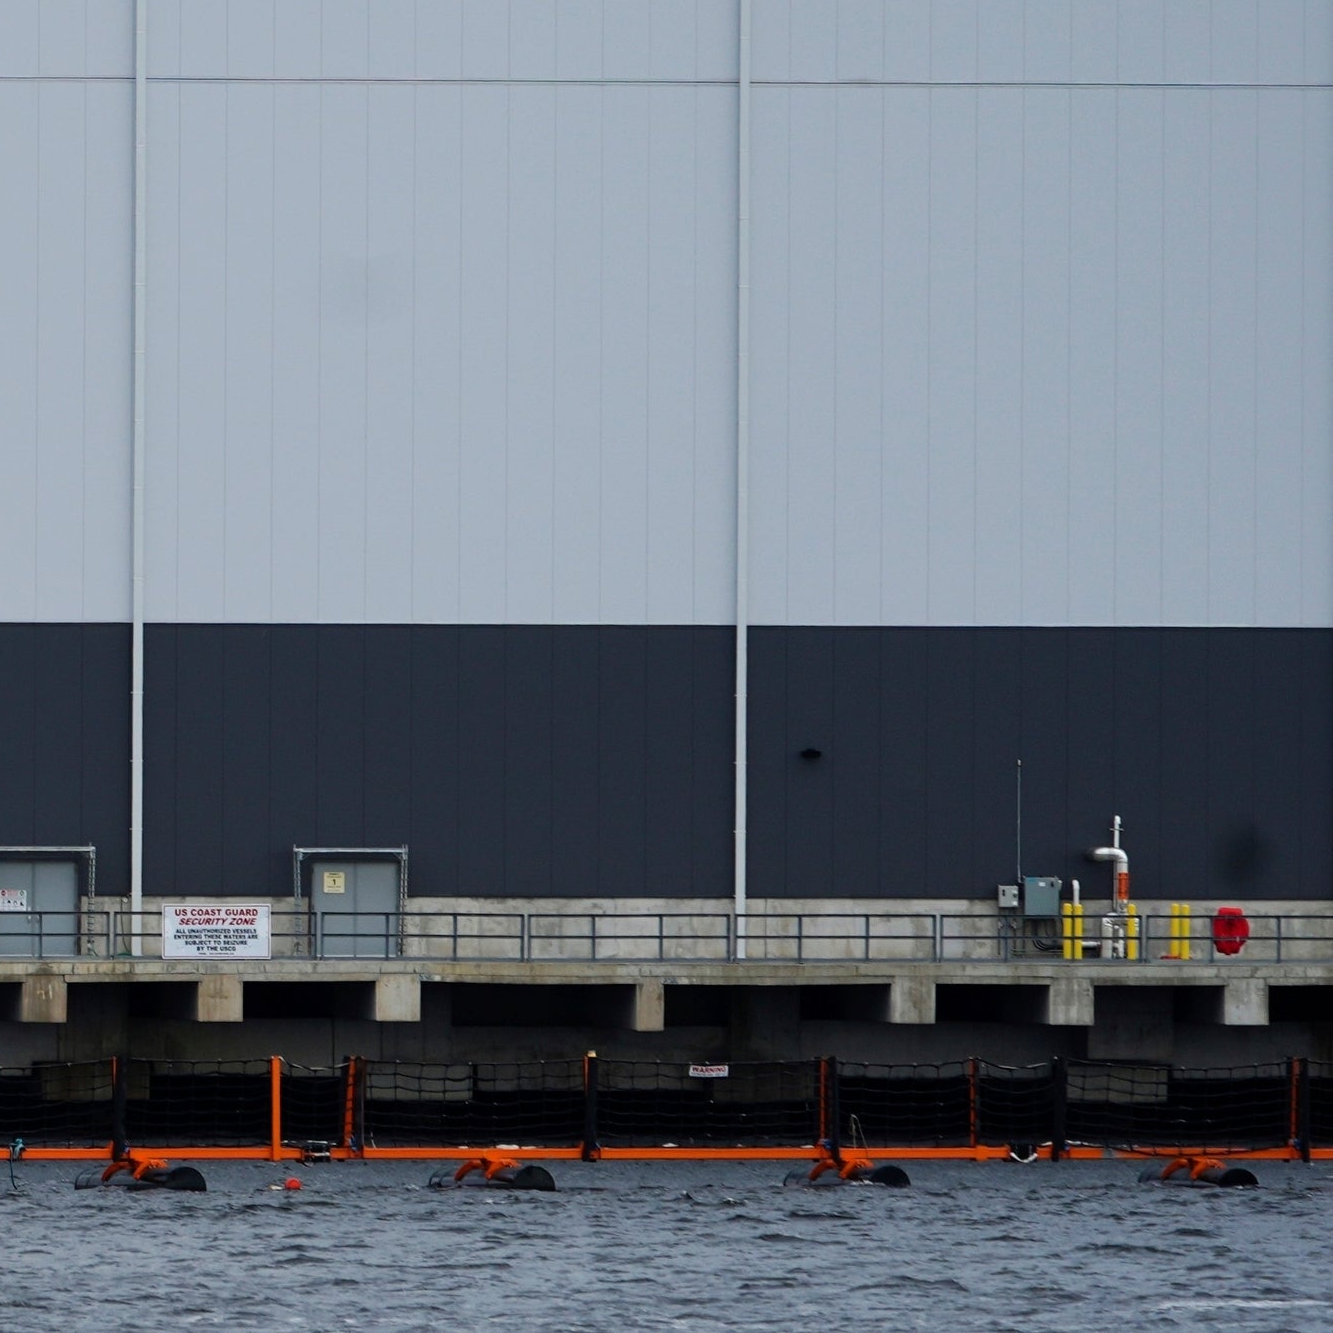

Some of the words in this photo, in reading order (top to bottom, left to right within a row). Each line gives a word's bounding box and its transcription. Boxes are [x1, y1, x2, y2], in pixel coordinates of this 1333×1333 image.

[174, 908, 188, 917] US
[190, 908, 222, 917] COAST
[225, 908, 259, 917] GUARD
[179, 917, 228, 926] SECURITY
[229, 917, 257, 926] ZONE
